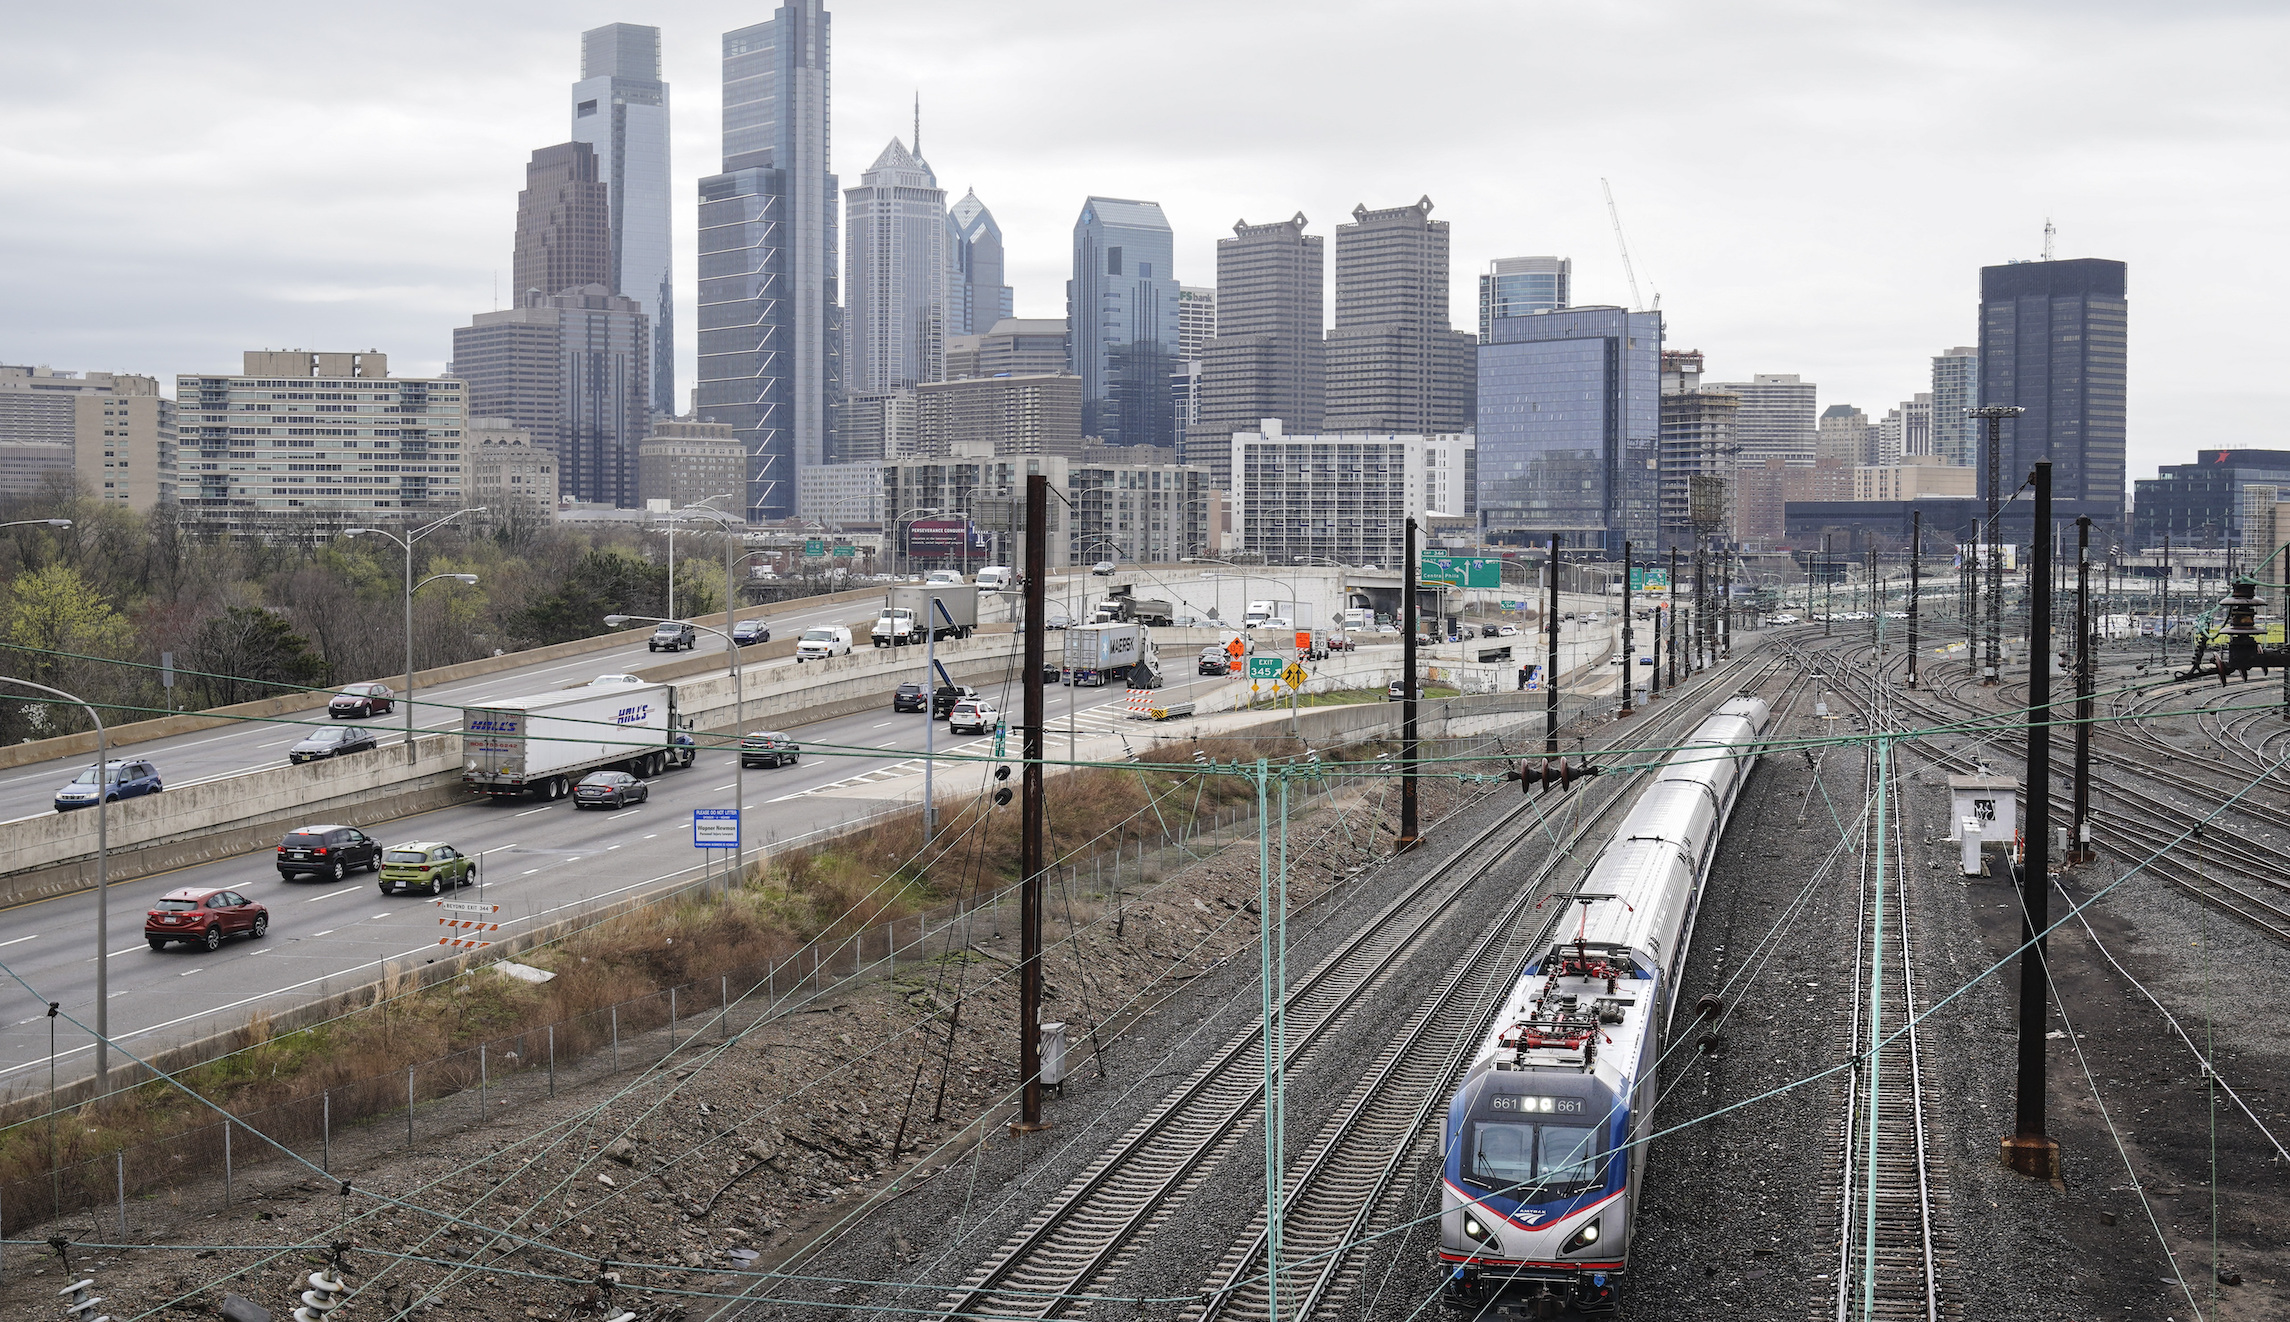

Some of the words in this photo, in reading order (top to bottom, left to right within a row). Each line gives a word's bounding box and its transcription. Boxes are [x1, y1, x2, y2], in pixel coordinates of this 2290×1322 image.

[1193, 292, 1212, 302] bank
[1110, 637, 1135, 654] MAERSK
[618, 704, 648, 724] HALL'S
[471, 721, 517, 731] HALL'S
[1494, 1098, 1517, 1109] 661
[1558, 1100, 1581, 1112] 661
